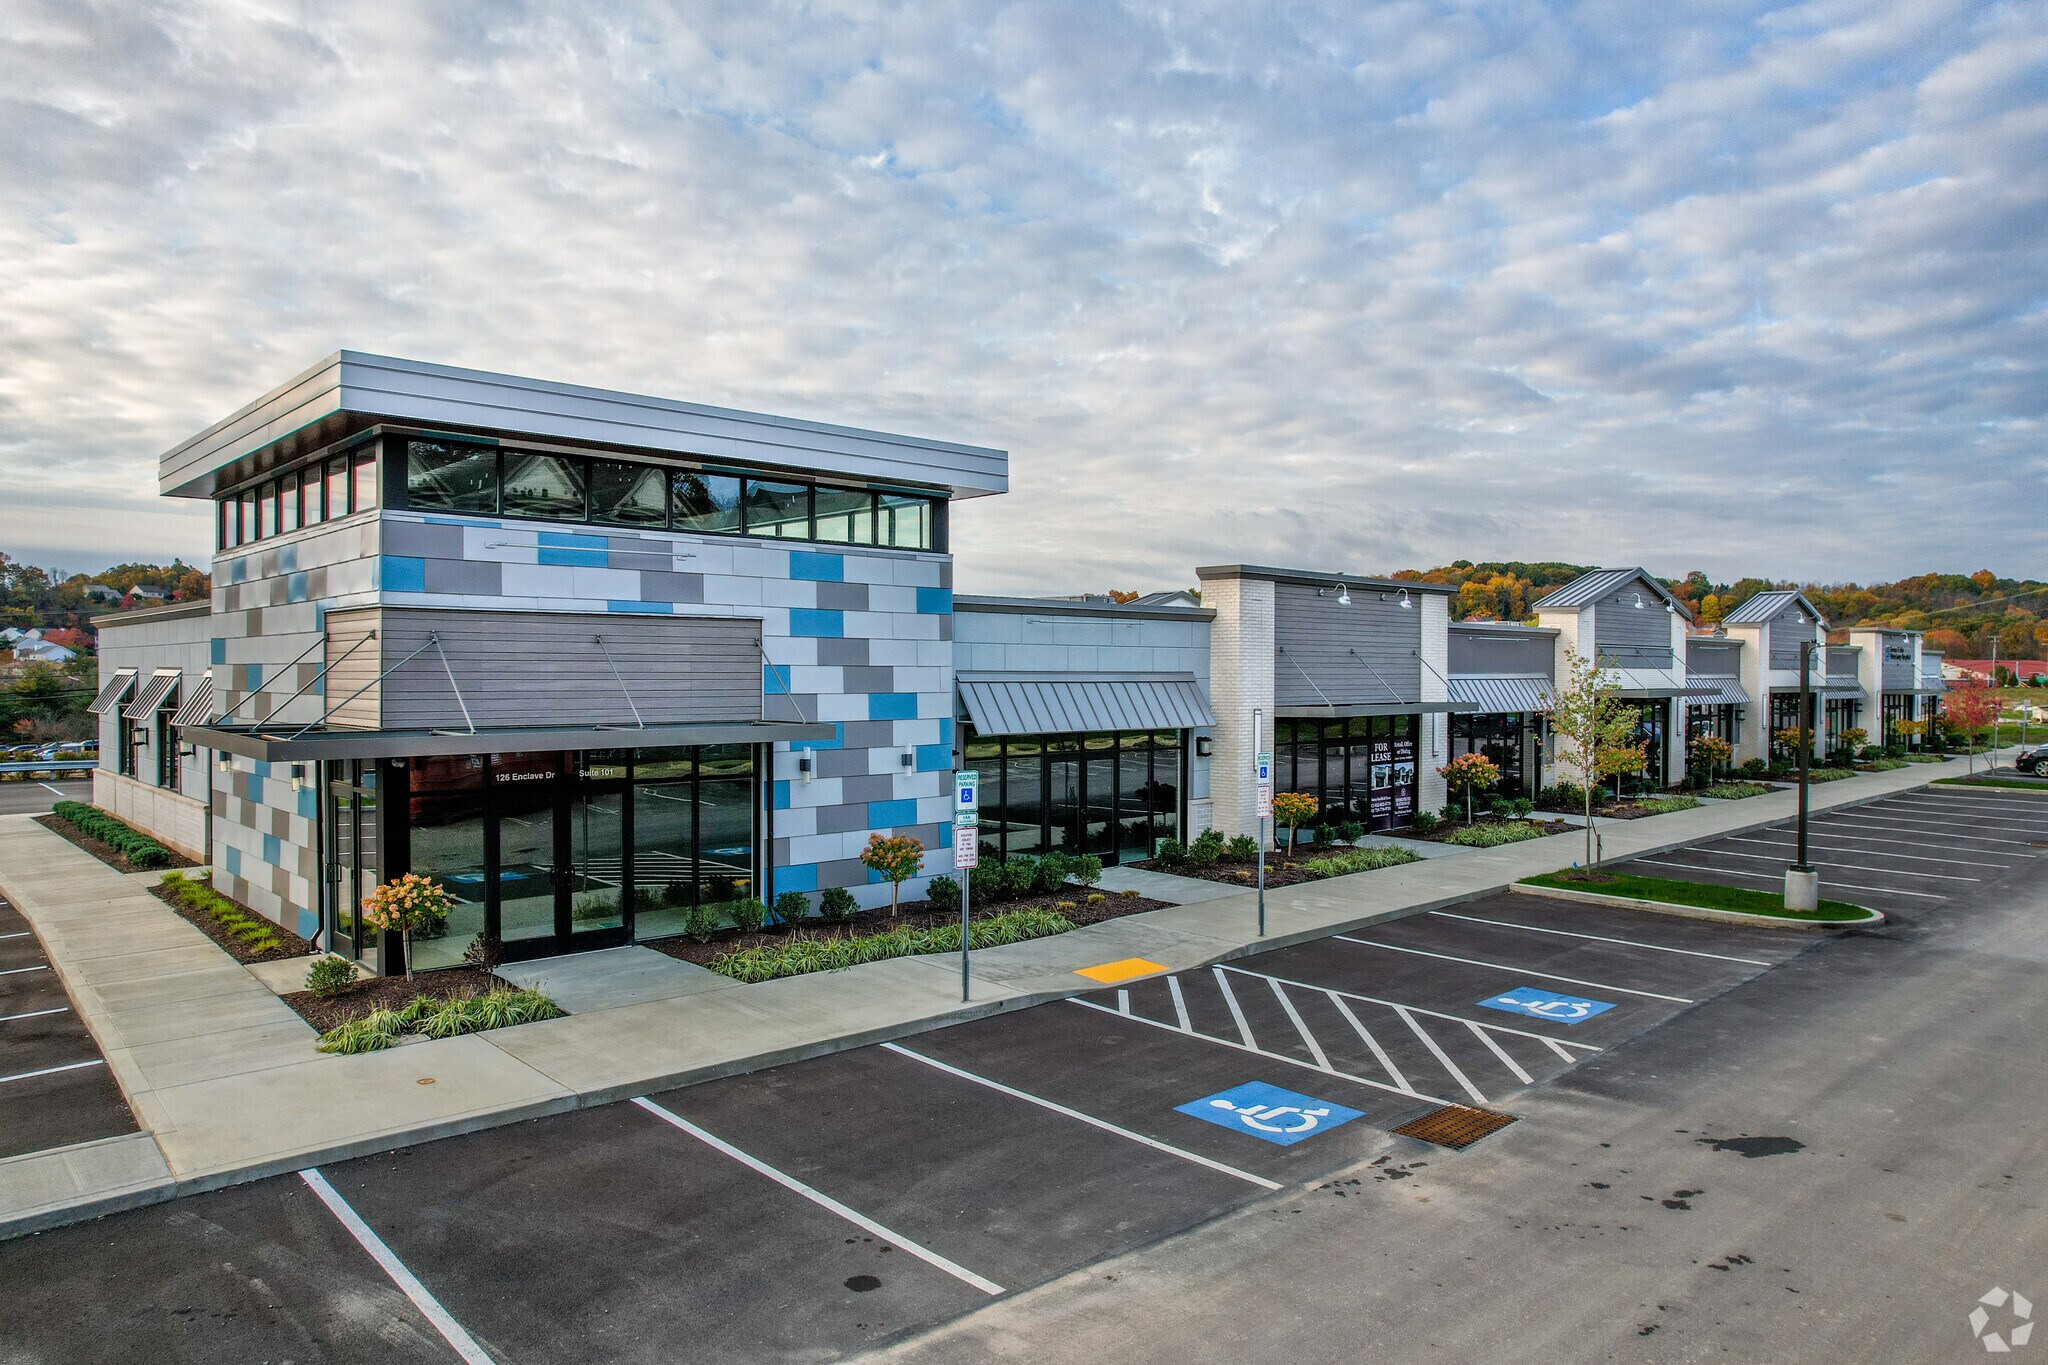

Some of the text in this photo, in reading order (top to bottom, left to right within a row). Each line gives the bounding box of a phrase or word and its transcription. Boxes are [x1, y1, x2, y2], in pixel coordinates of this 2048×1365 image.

[1374, 743, 1388, 752] FOR
[1371, 752, 1392, 762] LEASE
[495, 771, 556, 782] 126 Enclave Dr
[579, 768, 613, 777] Suite 101
